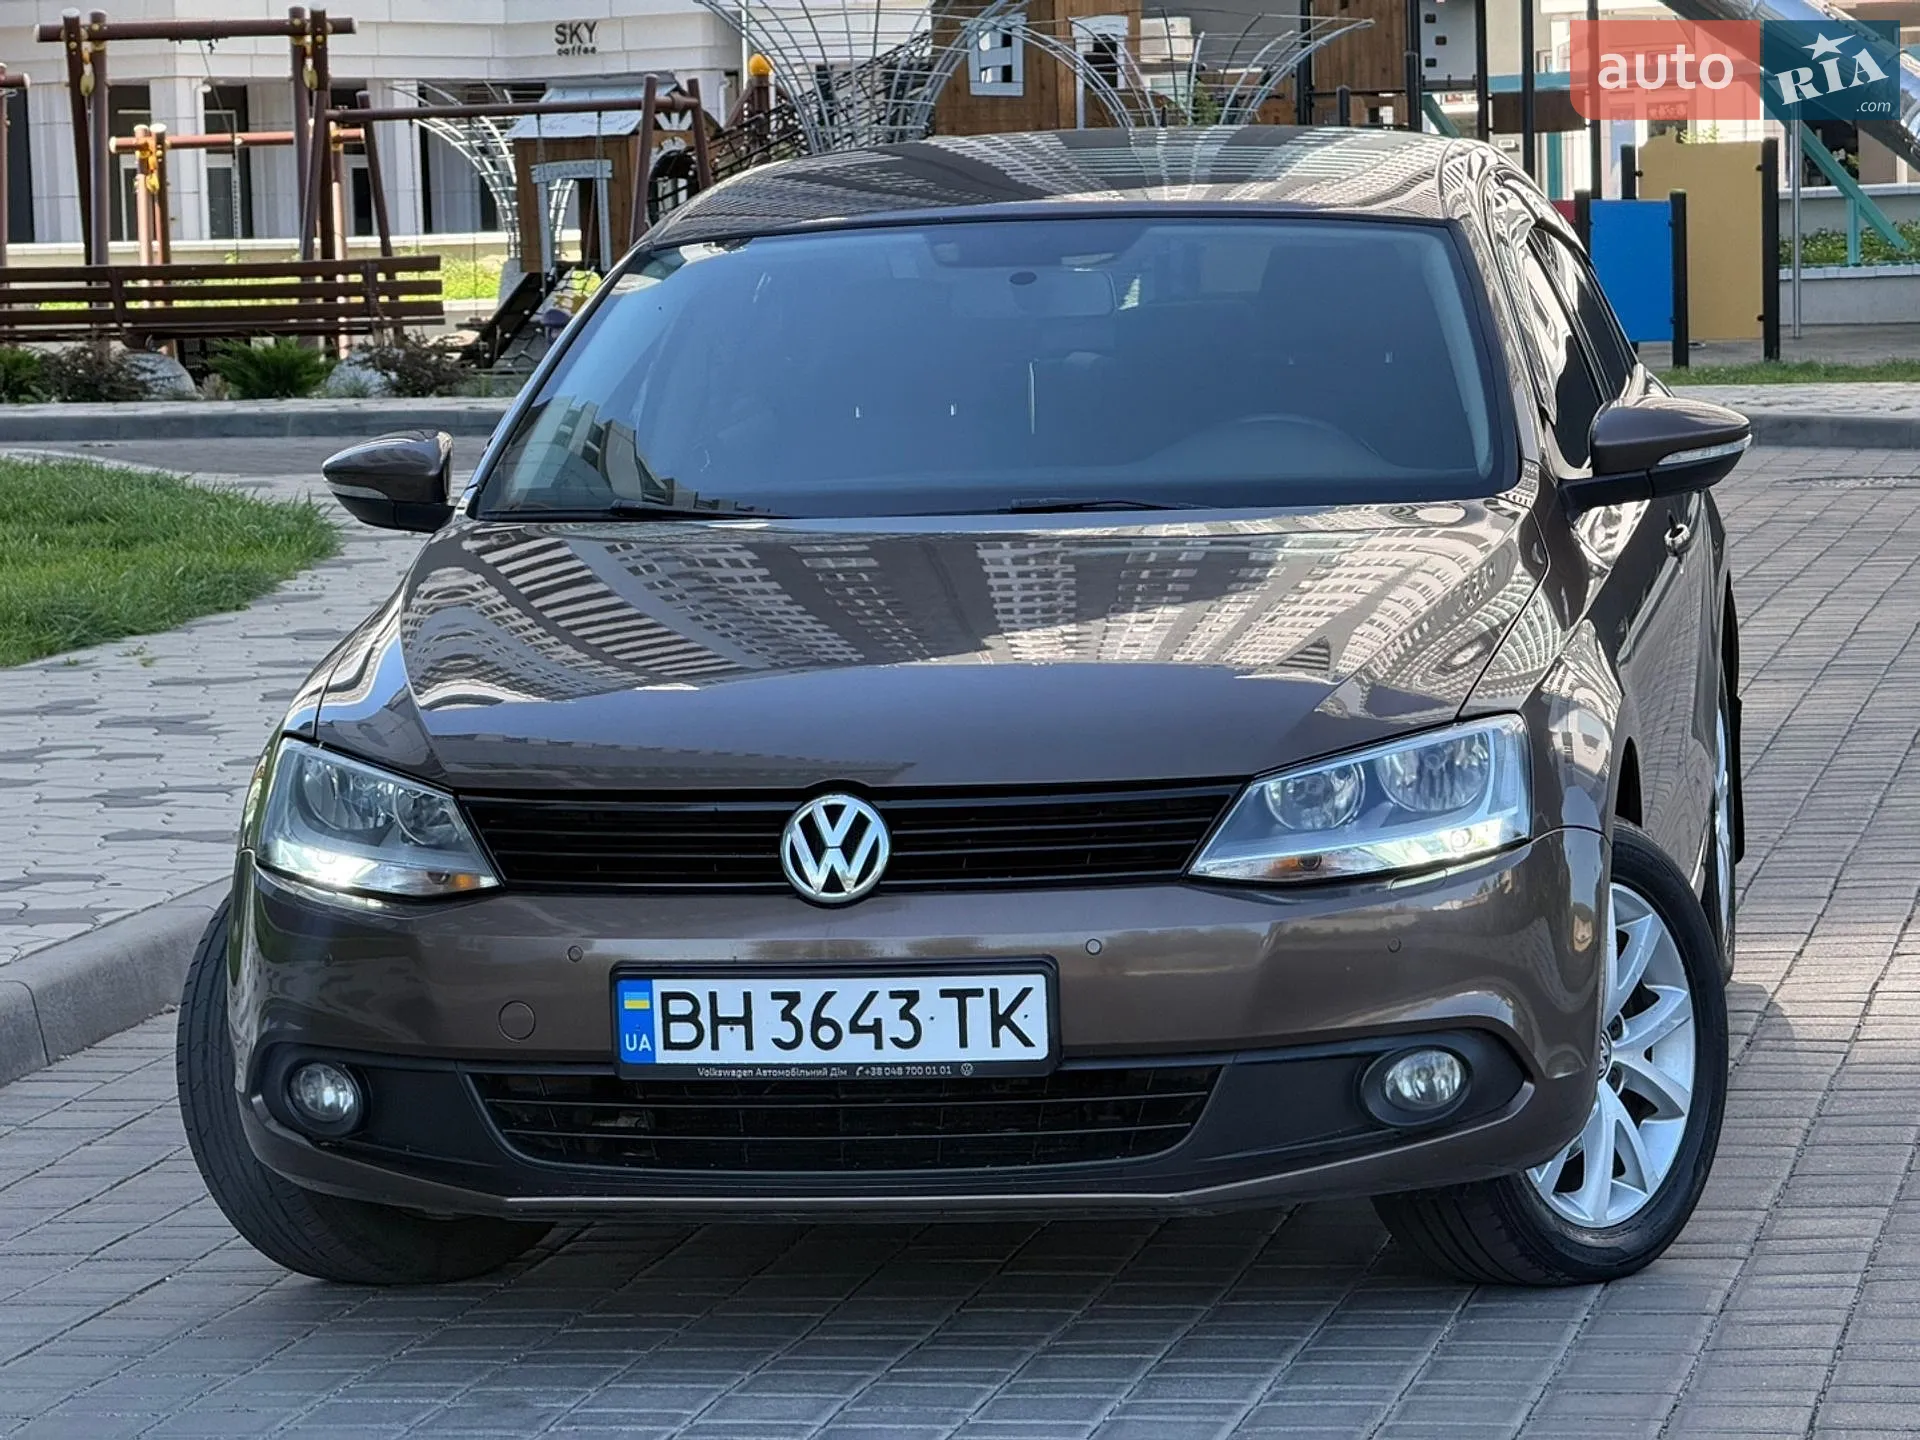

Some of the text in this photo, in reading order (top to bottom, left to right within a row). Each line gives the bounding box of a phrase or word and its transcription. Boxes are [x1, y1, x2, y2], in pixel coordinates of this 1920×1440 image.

[555, 21, 597, 45] SKY
[660, 987, 1036, 1051] BH 3643 TK
[625, 1033, 652, 1052] UA
[697, 1067, 753, 1078] Volkswagen
[905, 1066, 924, 1076] 700
[925, 1065, 938, 1076] 01
[940, 1065, 952, 1075] 01
